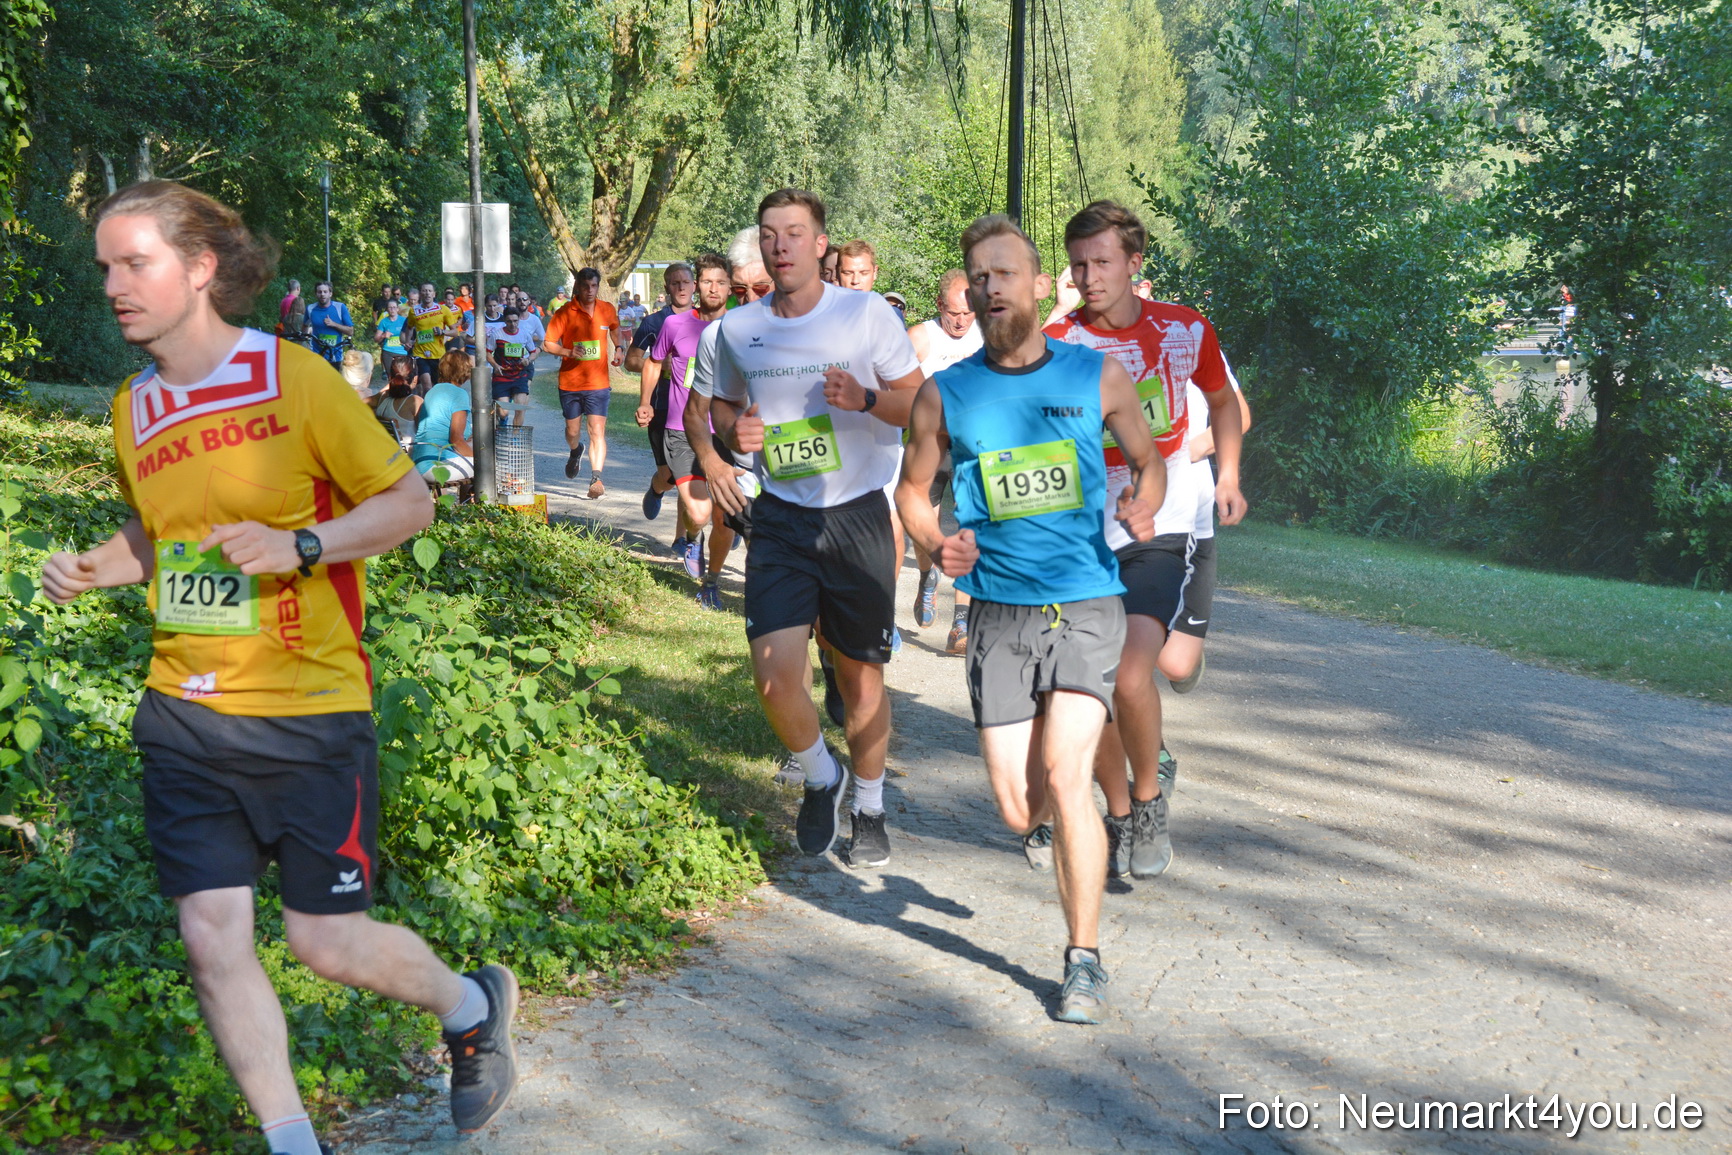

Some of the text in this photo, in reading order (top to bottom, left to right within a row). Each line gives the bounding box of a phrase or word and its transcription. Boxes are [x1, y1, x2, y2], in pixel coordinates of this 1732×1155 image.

[1041, 406, 1083, 418] THULE
[136, 413, 290, 483] MAX BÖGL
[773, 437, 827, 464] 1756
[997, 466, 1067, 499] 1939
[999, 491, 1071, 508] Schwandner Markus
[166, 572, 240, 607] 1202
[200, 607, 227, 618] Daniel
[275, 573, 304, 651] max
